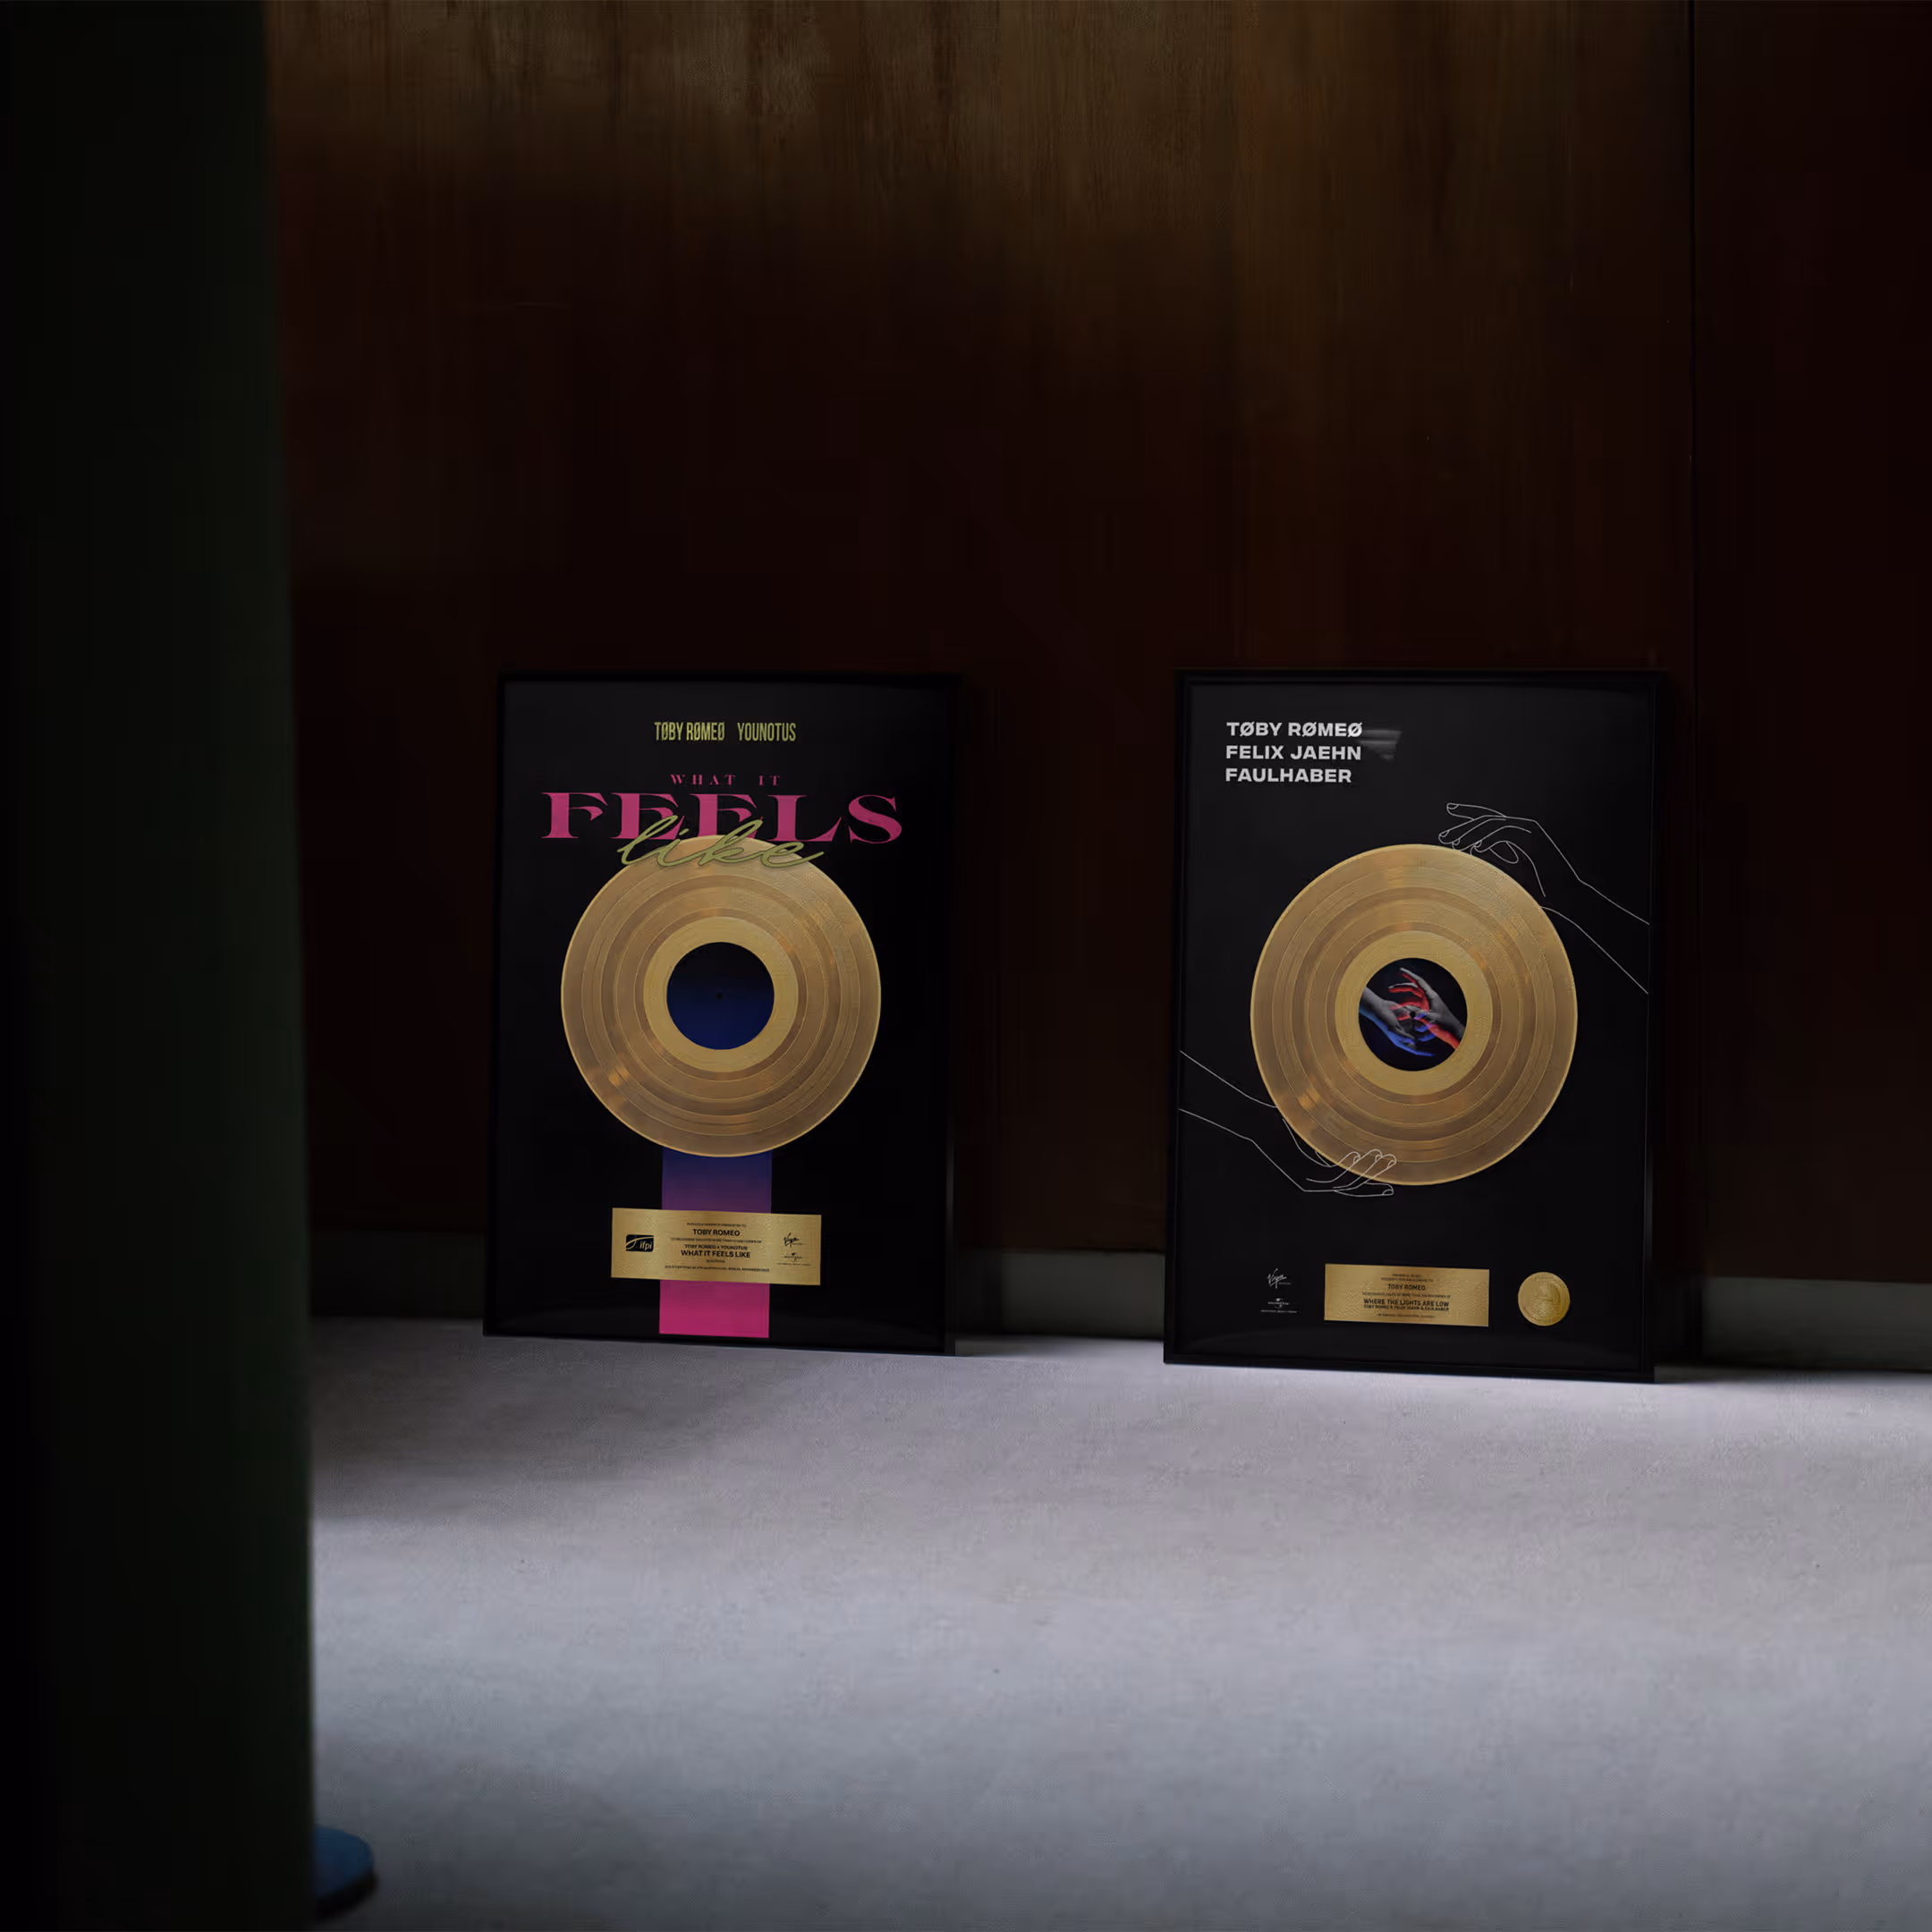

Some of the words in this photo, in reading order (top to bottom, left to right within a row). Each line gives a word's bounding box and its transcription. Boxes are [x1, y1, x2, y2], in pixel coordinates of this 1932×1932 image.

[654, 721, 683, 741] TØBY
[686, 721, 725, 741] RØMEØ
[737, 722, 797, 742] YOUNOTUS
[1226, 722, 1283, 737] TØBY
[1288, 722, 1363, 737] RØMEØ
[1226, 745, 1284, 759] FELIX
[1290, 746, 1362, 760] JAEHN
[670, 774, 736, 786] WHAT
[758, 775, 781, 786] IT
[1225, 767, 1352, 783] FAULHABER
[541, 792, 903, 844] FEELS
[617, 815, 826, 869] like
[713, 1229, 741, 1237] ROMEO
[640, 1241, 653, 1251] ifpi
